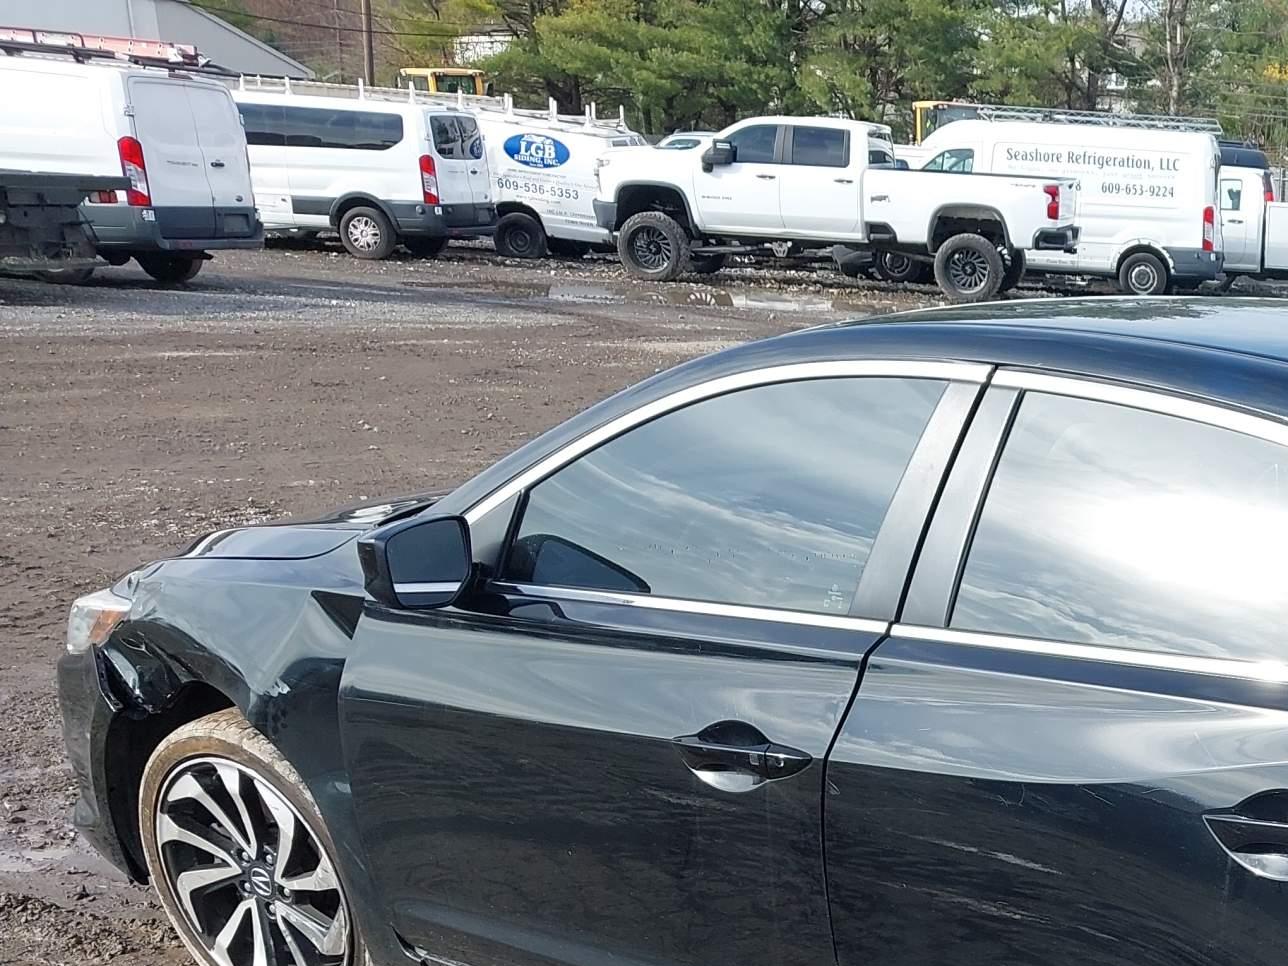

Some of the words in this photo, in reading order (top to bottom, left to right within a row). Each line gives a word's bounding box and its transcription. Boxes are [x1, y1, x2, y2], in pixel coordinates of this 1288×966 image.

[513, 154, 543, 164] SIDING,
[519, 140, 556, 159] LGB
[1006, 147, 1063, 164] Seashore
[1067, 150, 1155, 172] Refrigeration,
[1159, 158, 1181, 172] LLC
[497, 178, 580, 200] 609-536-5353
[1101, 182, 1175, 198] 609-653-9224
